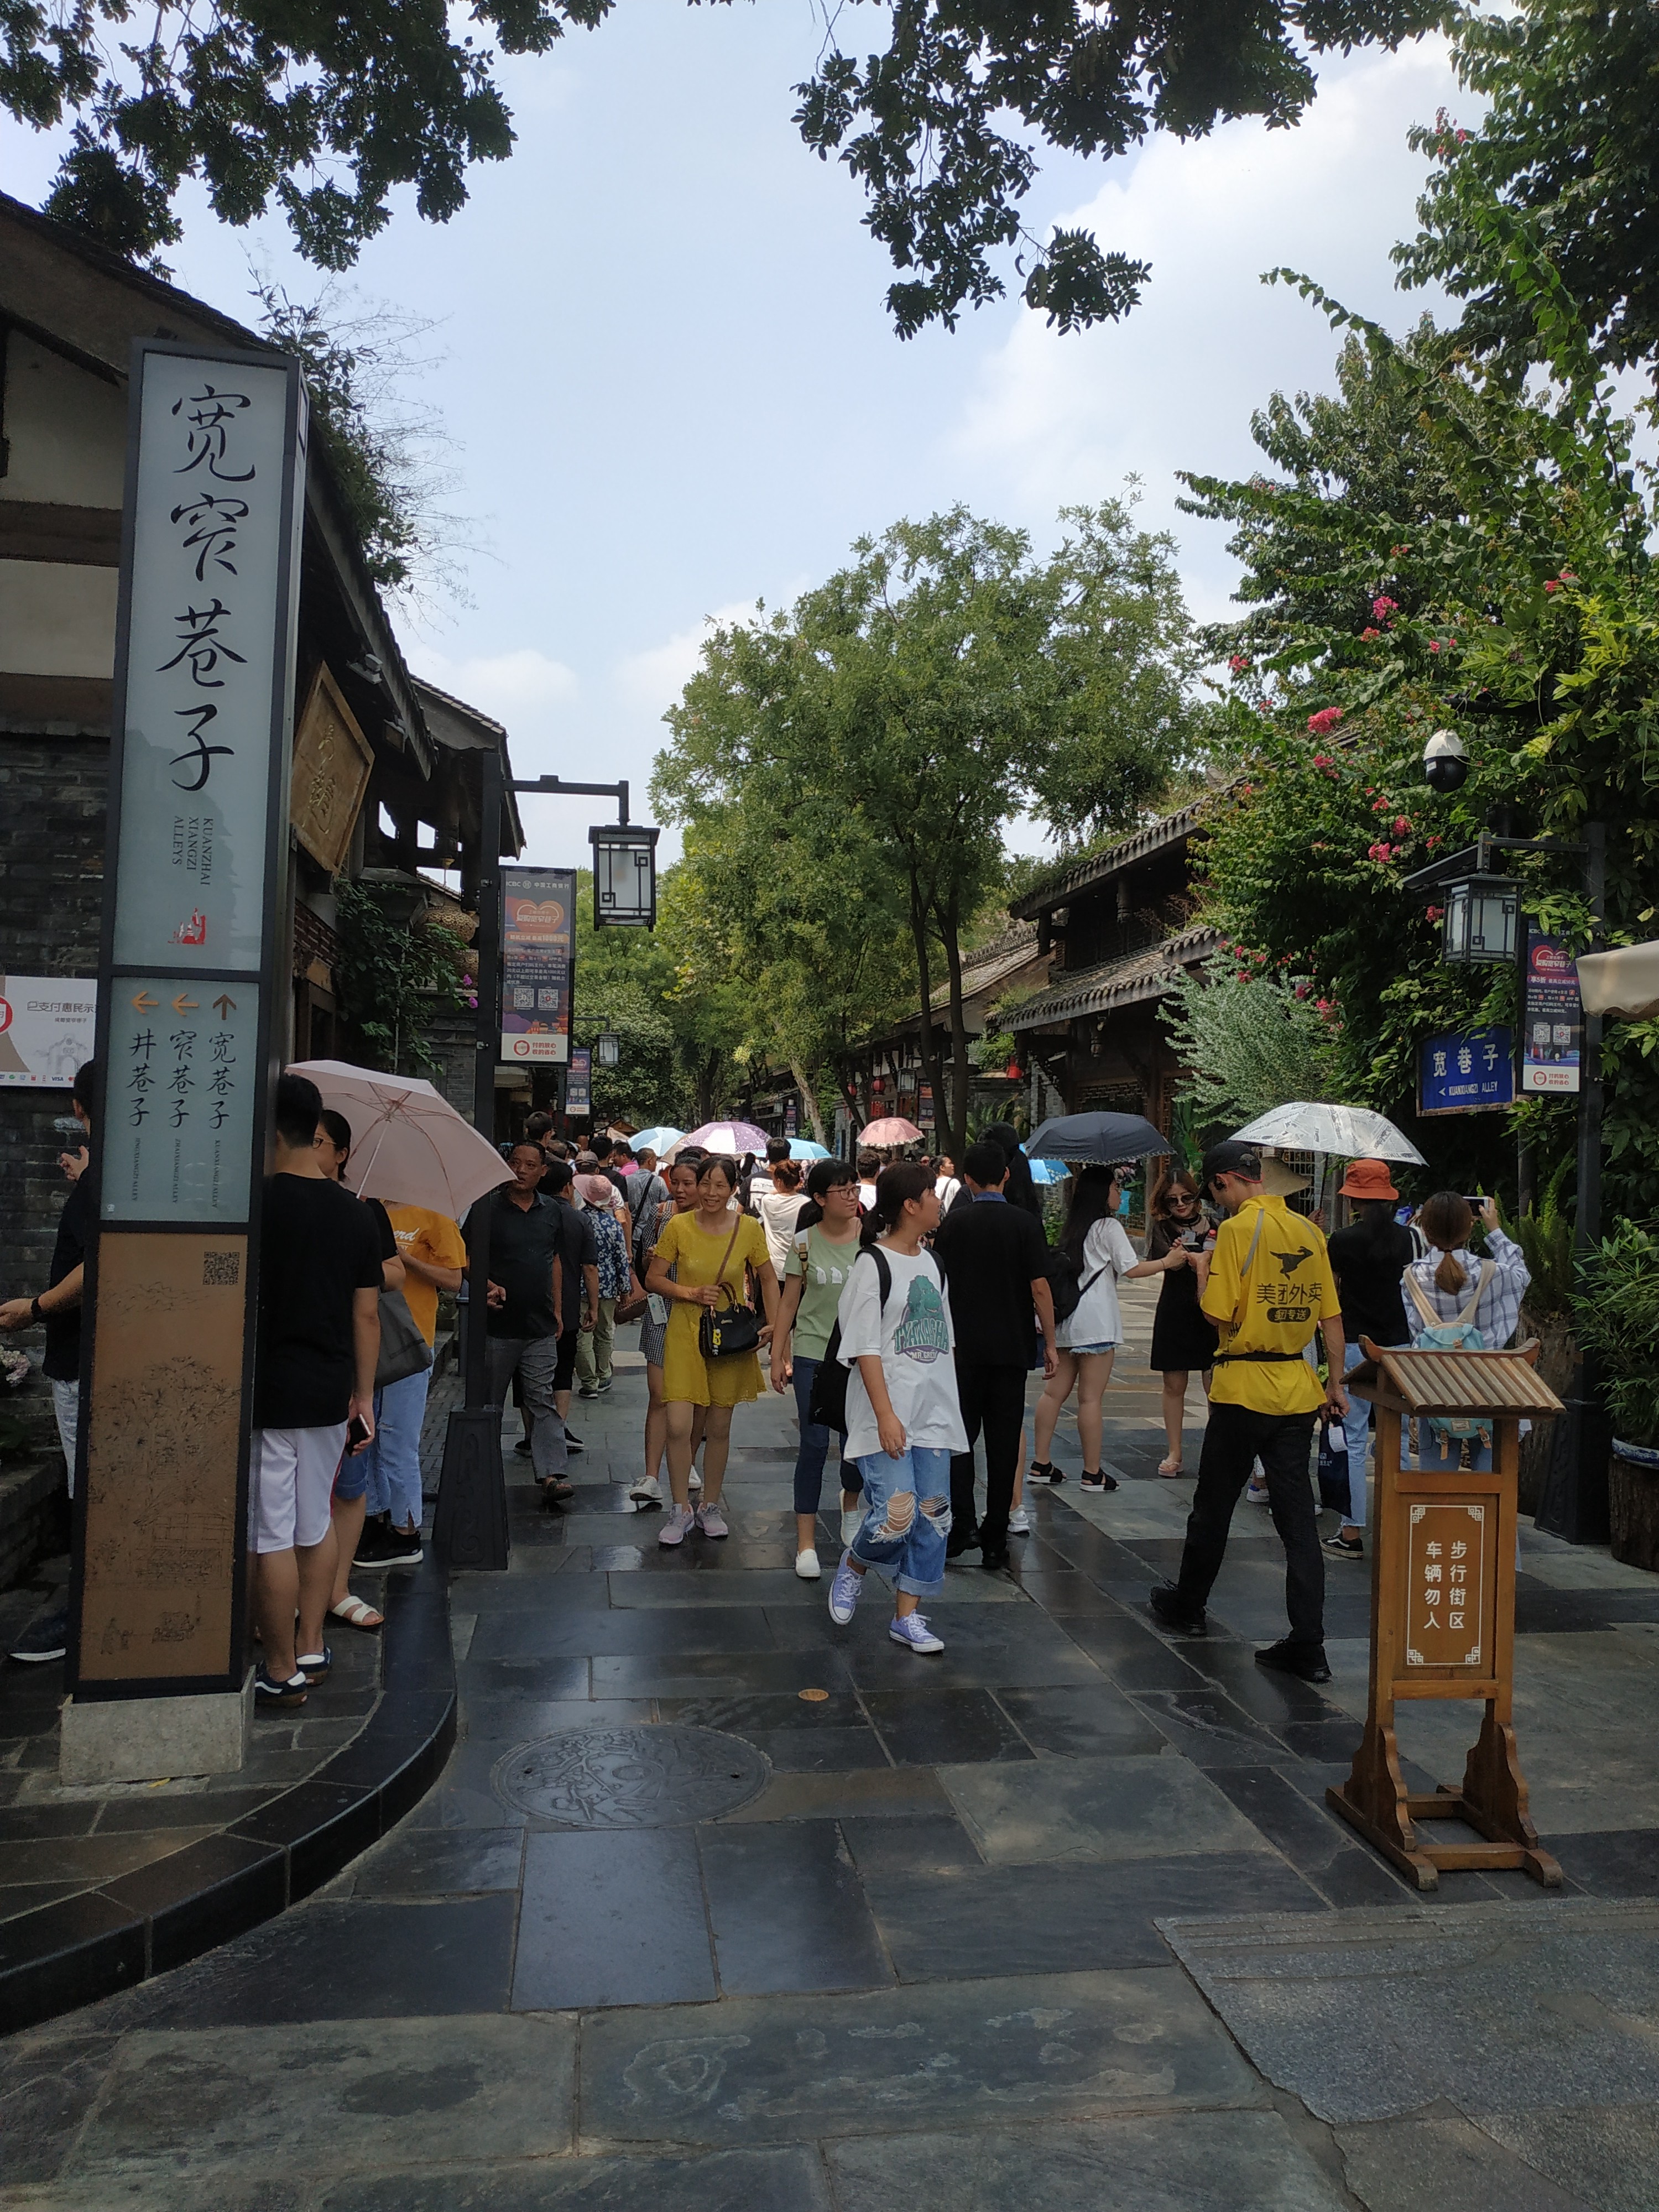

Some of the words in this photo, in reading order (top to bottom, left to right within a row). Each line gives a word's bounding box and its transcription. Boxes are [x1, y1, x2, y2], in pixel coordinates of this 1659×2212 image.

[155, 383, 255, 791] 宽窄巷子
[172, 816, 184, 865] ALLEYS
[186, 817, 199, 870] XIANGZI
[200, 818, 213, 885] KUANZHAI
[126, 1028, 157, 1128] 井巷子
[167, 1030, 197, 1129] 窄巷子
[206, 1032, 237, 1130] 宽巷子
[1433, 1044, 1499, 1077] 宽巷子
[1481, 1081, 1498, 1093] ALLEY
[1256, 1282, 1322, 1305] 美团外卖
[1449, 1540, 1467, 1629] 步行街区
